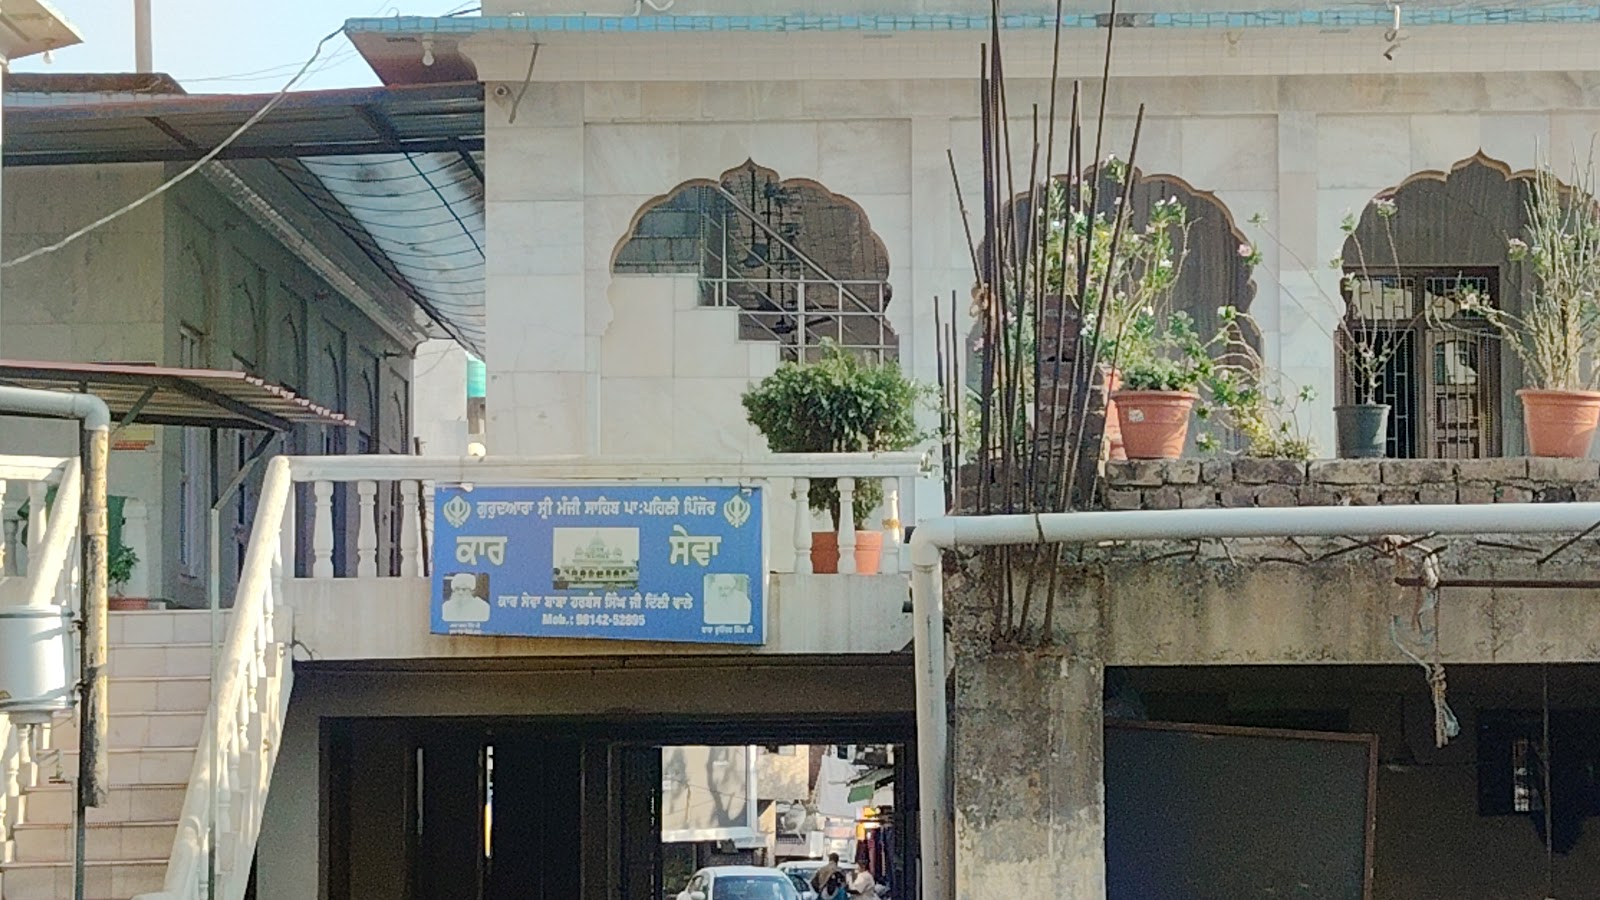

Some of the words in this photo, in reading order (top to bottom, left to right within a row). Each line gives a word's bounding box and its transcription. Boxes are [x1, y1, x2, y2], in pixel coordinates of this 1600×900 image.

[557, 496, 581, 515] ਮੰਜੀ
[584, 496, 621, 515] ਸਾਹਿਬ
[456, 536, 508, 566] ਕਾਰ
[669, 525, 722, 566] ਸੇਵਾ
[498, 595, 518, 608] ਕਾਰ
[521, 592, 542, 608] ਸੇਵਾ
